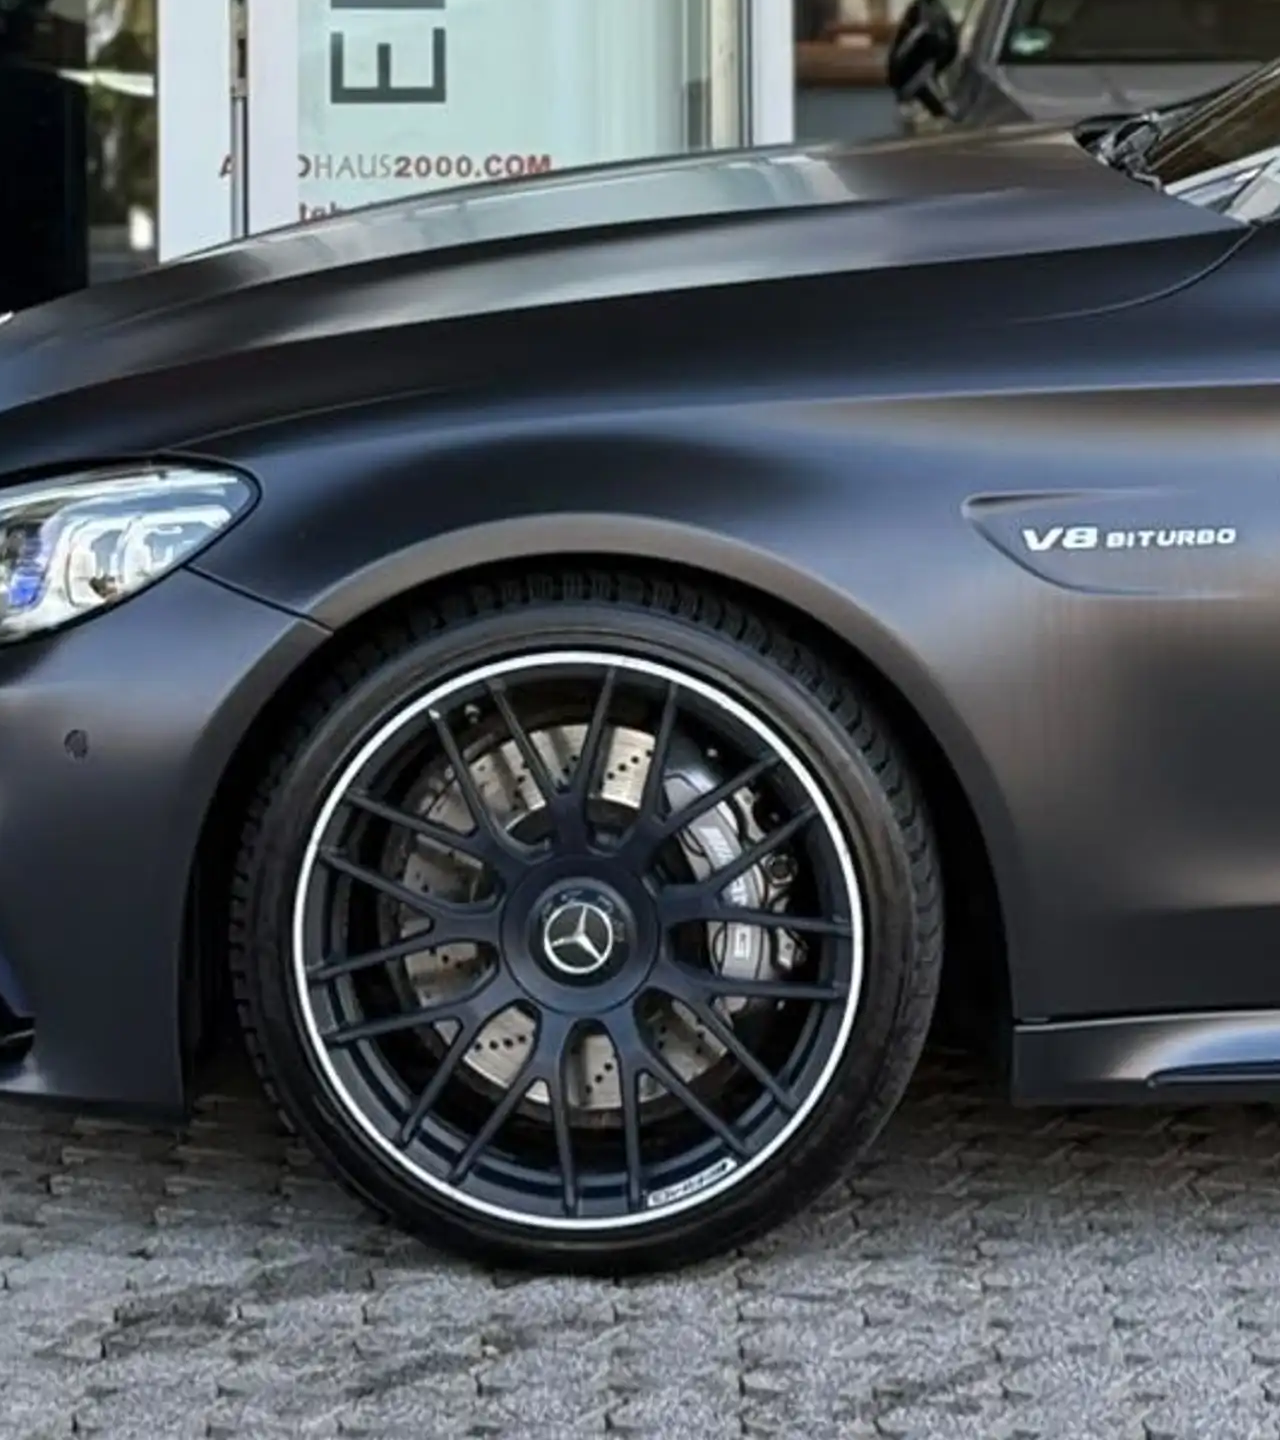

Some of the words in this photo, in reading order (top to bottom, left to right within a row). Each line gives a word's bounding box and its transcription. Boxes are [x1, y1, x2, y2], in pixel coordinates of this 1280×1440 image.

[219, 153, 552, 181] AOHAUS2000.COM
[1022, 526, 1099, 551] V8
[1105, 527, 1237, 549] BITURBO
